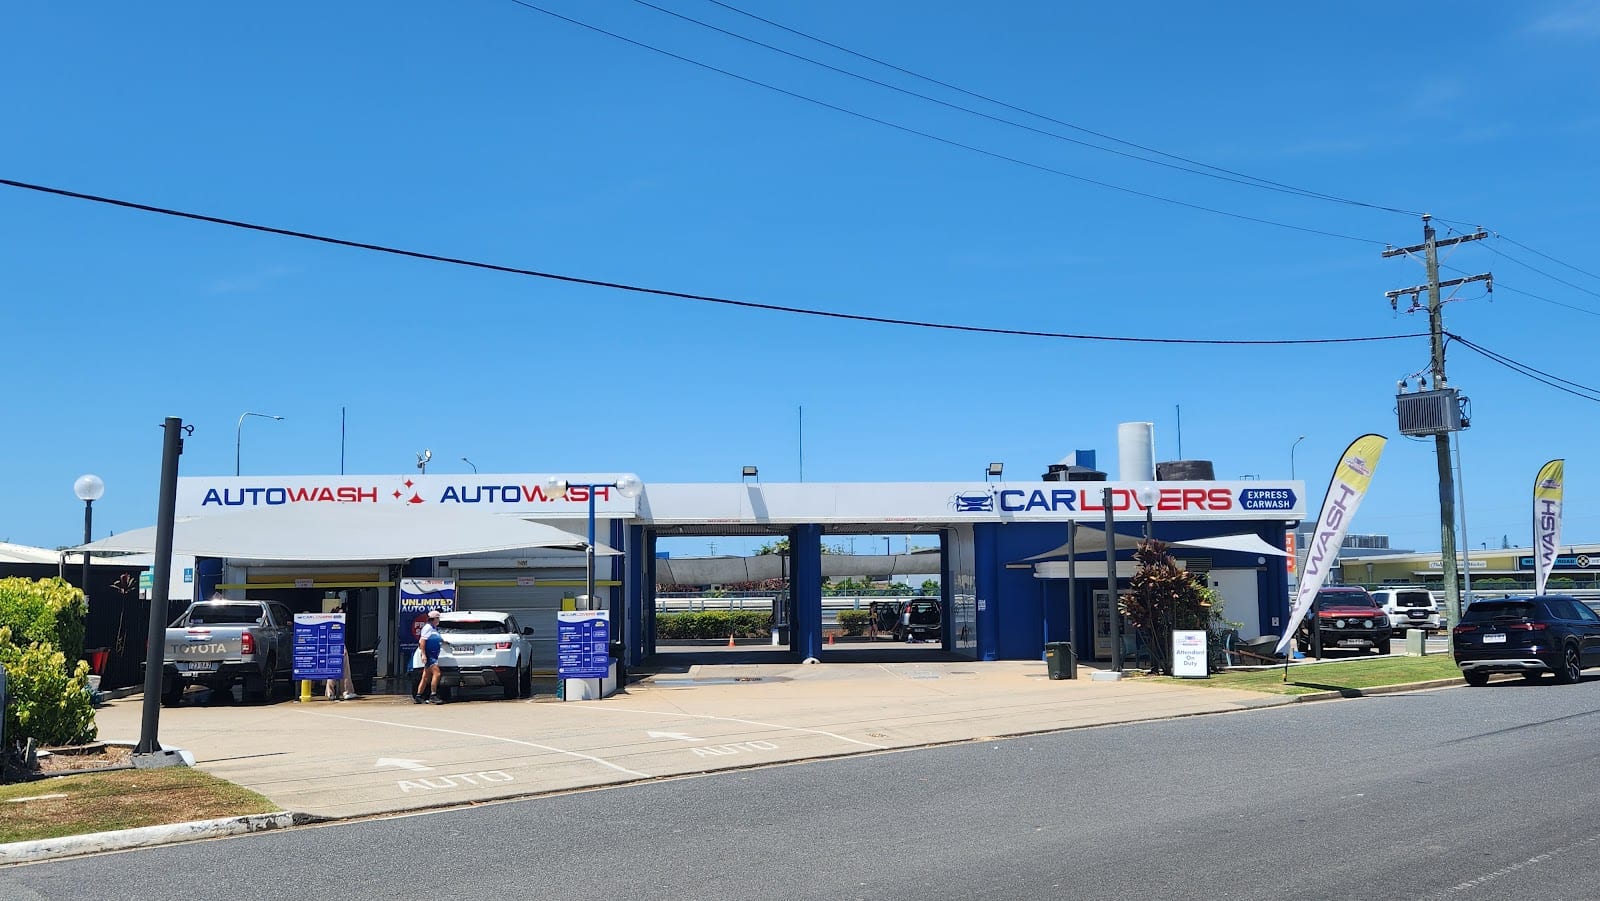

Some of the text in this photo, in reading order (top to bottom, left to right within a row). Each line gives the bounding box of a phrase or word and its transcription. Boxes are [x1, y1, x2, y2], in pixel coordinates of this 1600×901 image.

[202, 487, 377, 505] AUTOWASH
[1246, 500, 1290, 508] CARWASH
[1248, 491, 1288, 499] EXPRESS
[1306, 484, 1354, 576] WASH
[1541, 500, 1555, 567] WASH
[402, 598, 453, 606] UNLIMITED
[171, 643, 227, 654] TOYOTA
[690, 740, 778, 758] AUTO
[398, 771, 514, 793] AUTO
